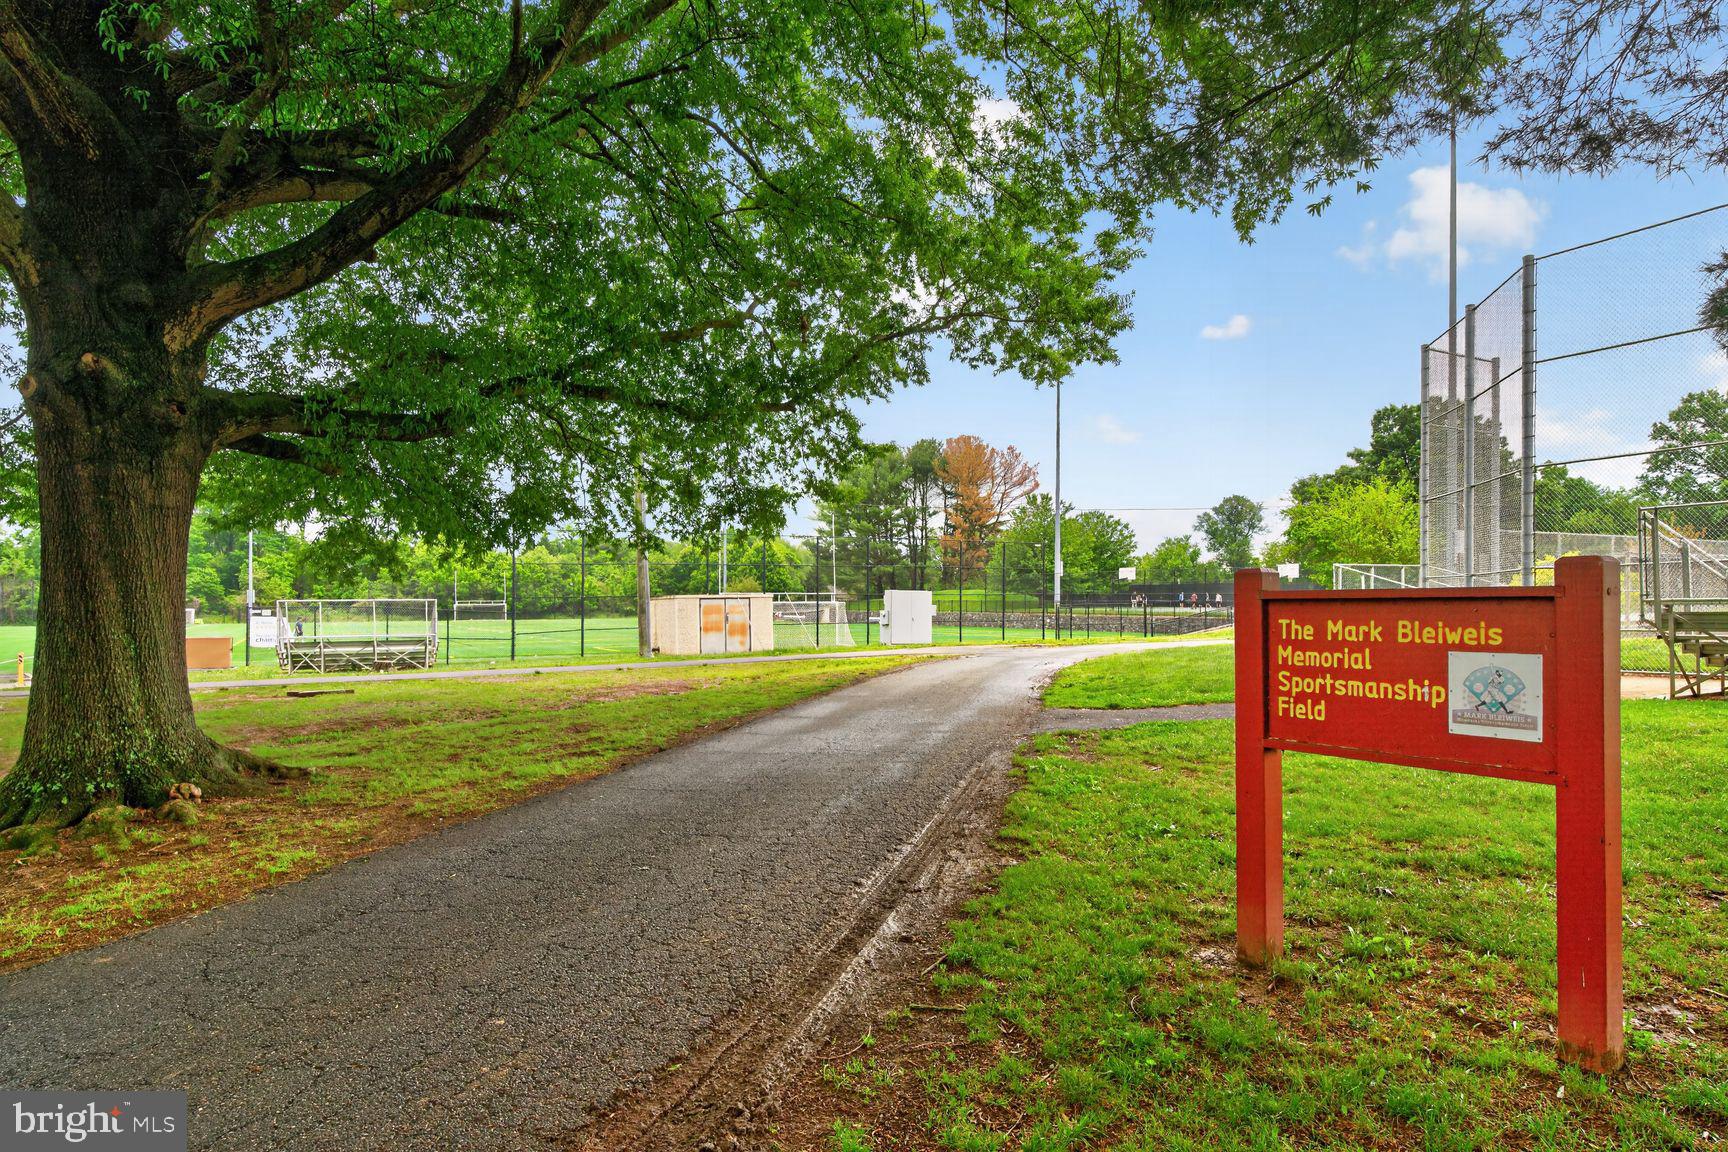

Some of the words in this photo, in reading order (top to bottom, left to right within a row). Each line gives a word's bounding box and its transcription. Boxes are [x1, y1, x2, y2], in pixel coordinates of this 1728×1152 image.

[1278, 618, 1314, 642] The
[1327, 619, 1383, 643] Mark
[1397, 619, 1503, 647] Bleiweis
[1278, 645, 1372, 671] Memorial
[1278, 671, 1446, 709] Sportsmanship
[1278, 696, 1326, 722] Field
[1463, 711, 1487, 720] MARK
[1488, 713, 1526, 723] BLEIWEIS
